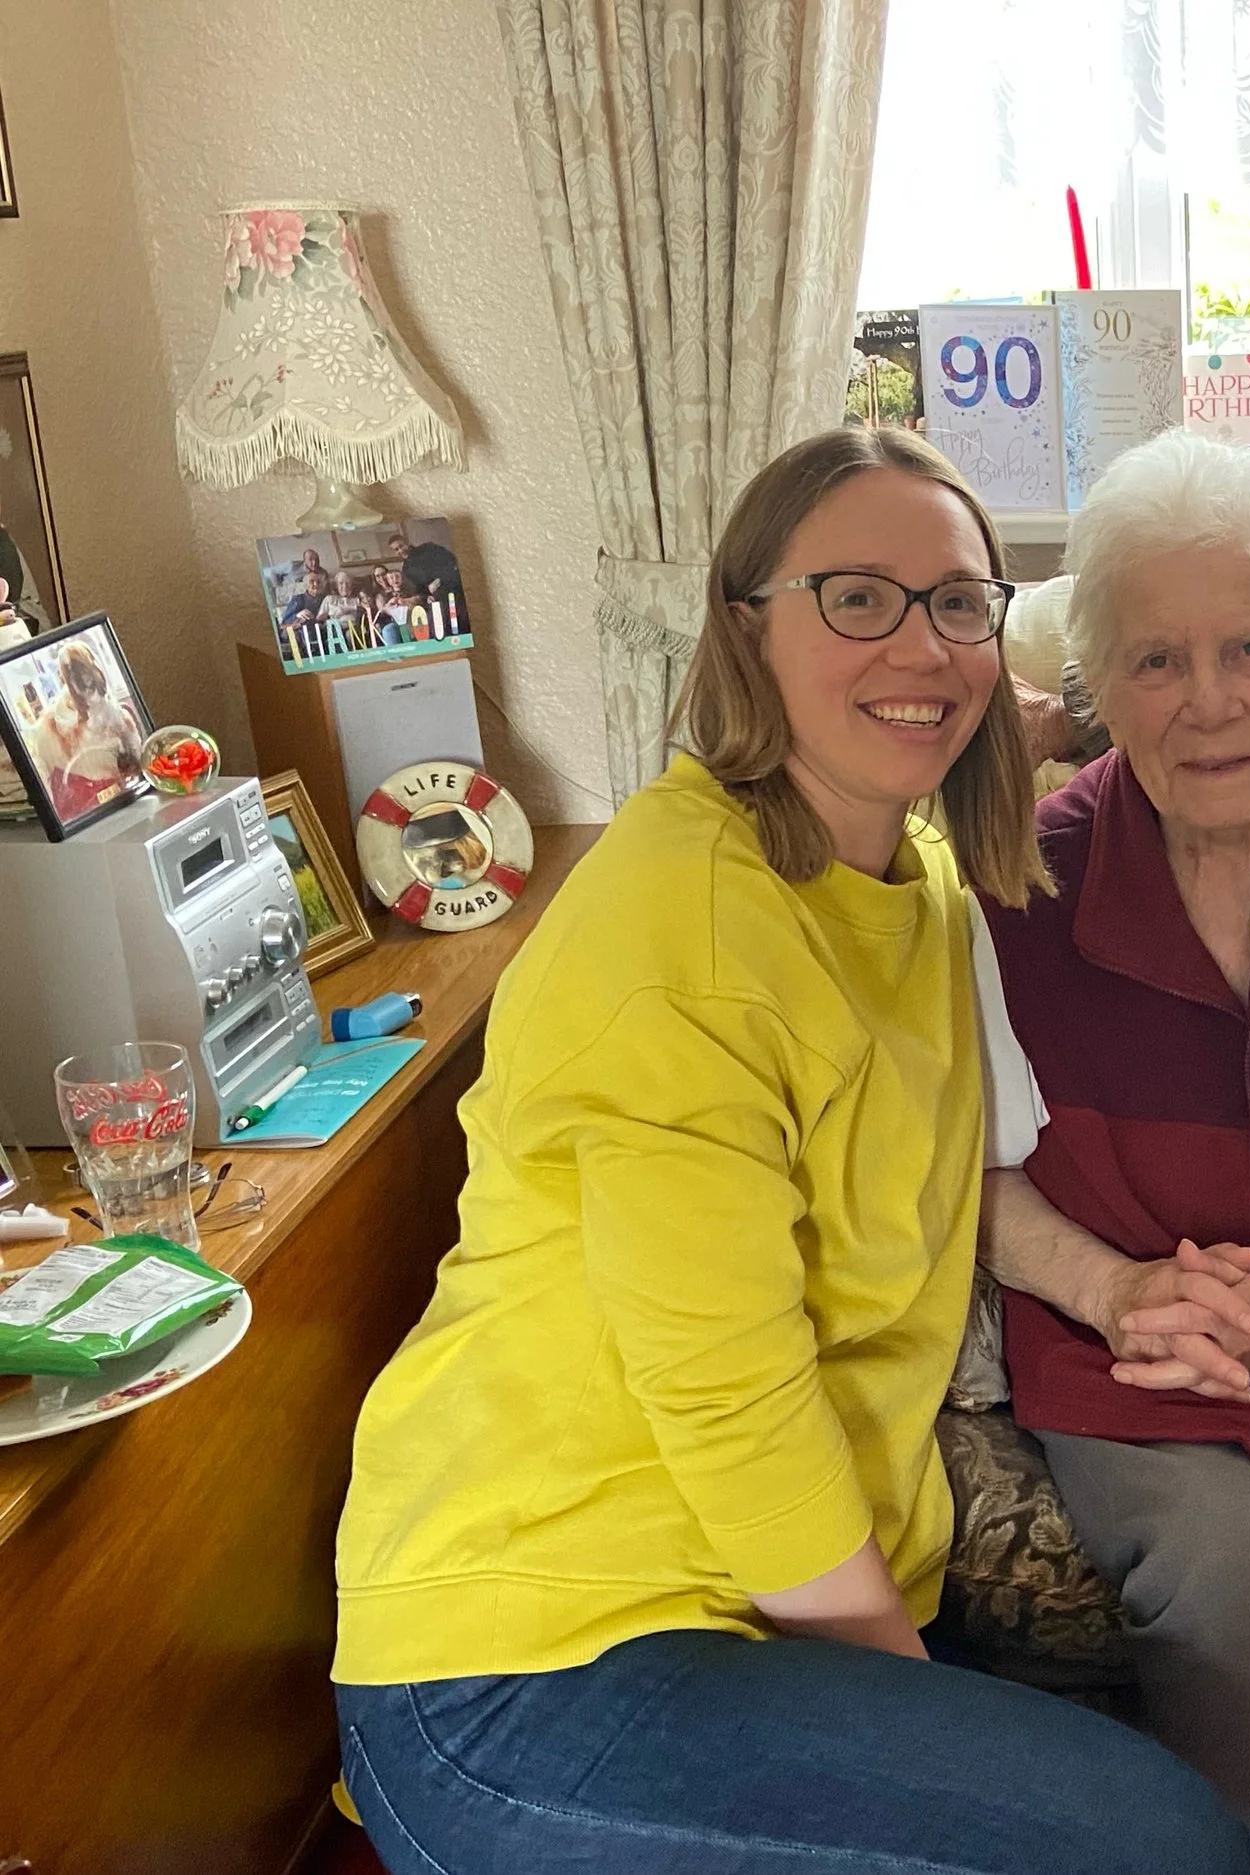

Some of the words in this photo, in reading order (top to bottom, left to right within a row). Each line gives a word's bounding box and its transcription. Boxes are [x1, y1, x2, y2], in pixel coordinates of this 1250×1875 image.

[867, 326, 893, 338] Happy
[894, 326, 915, 337] 90th
[940, 335, 1042, 409] 90
[936, 415, 984, 454] Happy
[958, 436, 1041, 500] Birthday
[286, 606, 389, 669] THANK
[403, 773, 457, 797] LIFE
[188, 826, 211, 845] SONY
[434, 890, 498, 916] GUARD
